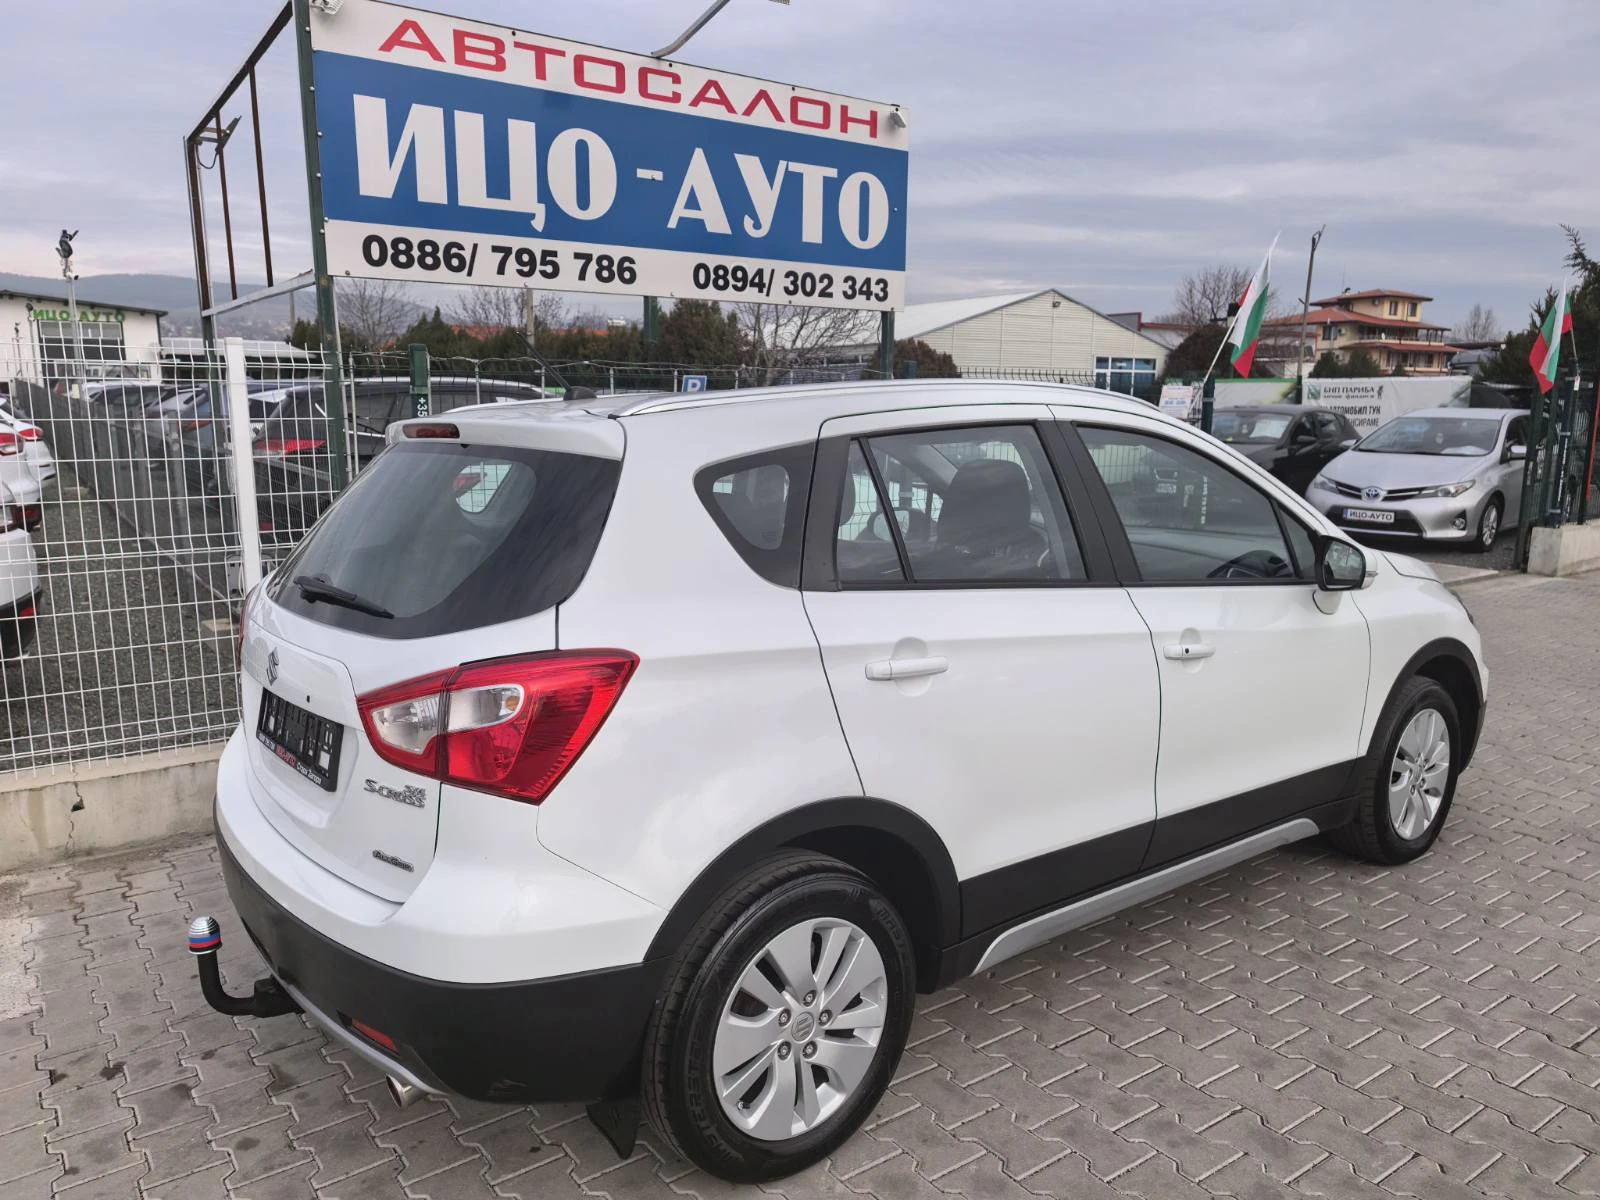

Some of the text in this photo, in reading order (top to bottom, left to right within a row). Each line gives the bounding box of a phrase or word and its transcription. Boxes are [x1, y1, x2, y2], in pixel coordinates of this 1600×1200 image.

[378, 19, 878, 138] АВТОСАЛОН
[352, 94, 617, 232] ИЦО
[362, 234, 889, 302] 0886/ 795 786 0894/ 302 343
[79, 310, 124, 323] АУТО
